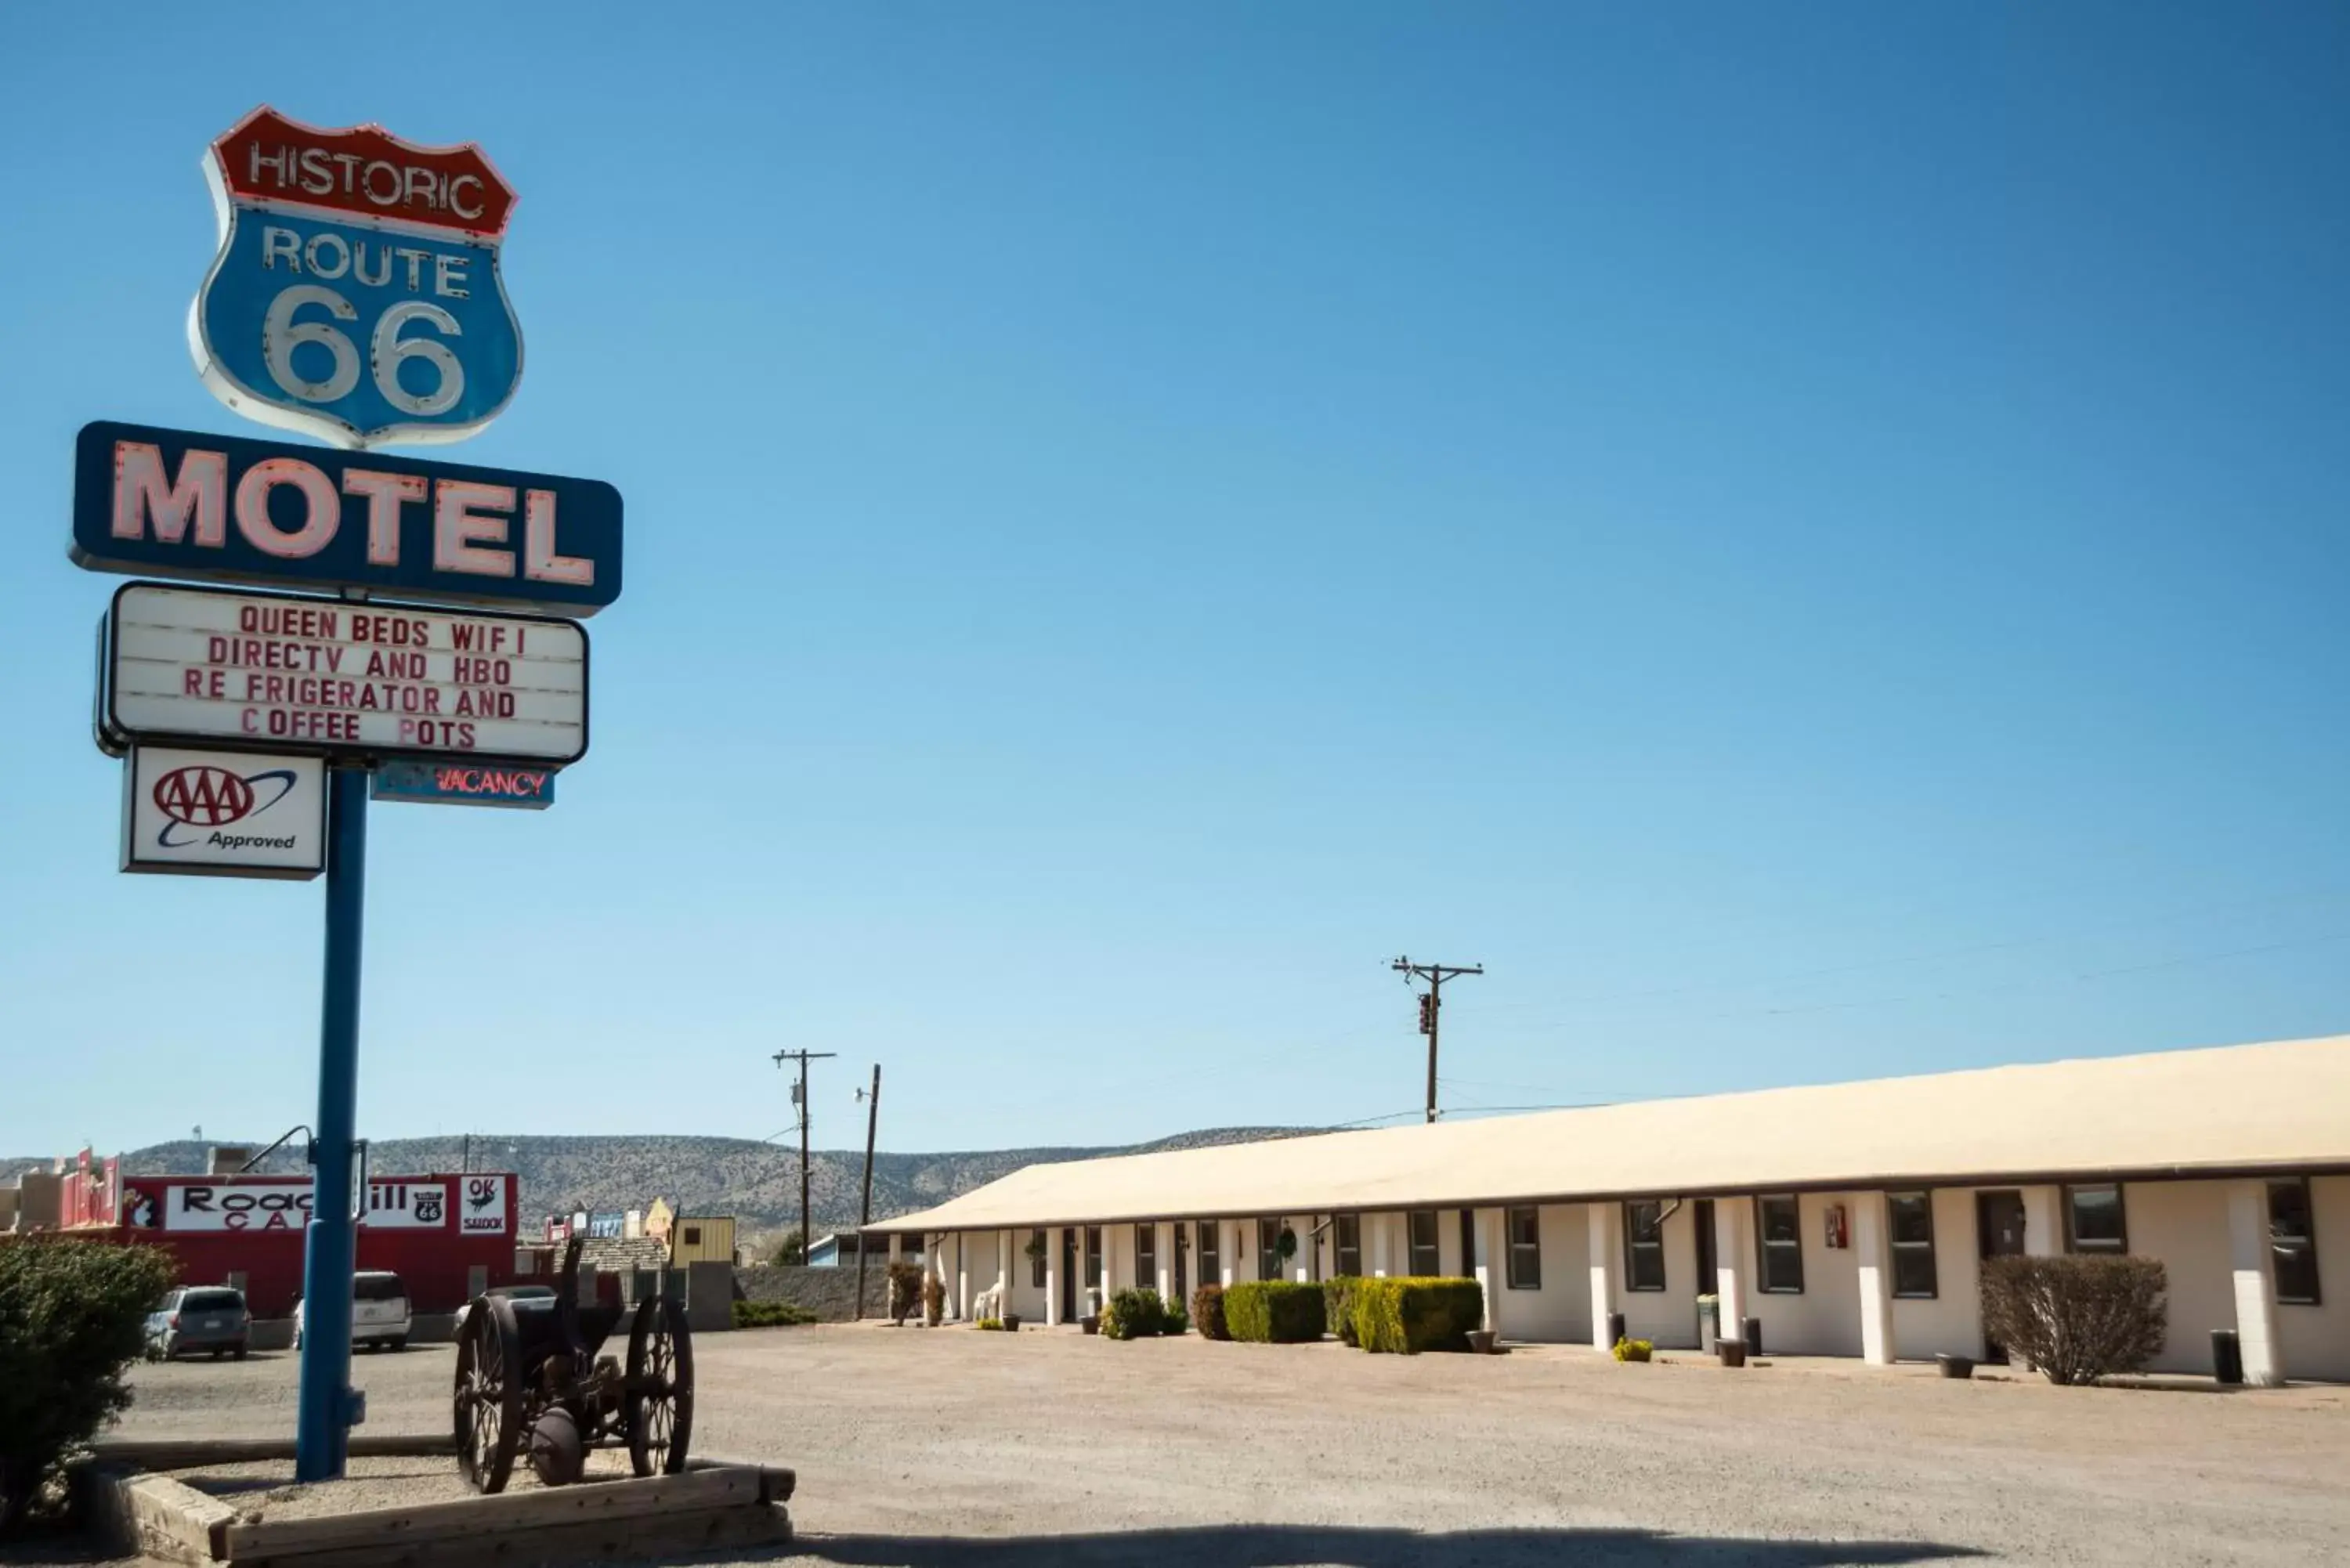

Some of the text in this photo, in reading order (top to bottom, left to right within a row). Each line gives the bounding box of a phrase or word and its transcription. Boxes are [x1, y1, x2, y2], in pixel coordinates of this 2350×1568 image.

[249, 140, 484, 220] HISTORIC
[261, 226, 471, 300] ROUTE
[262, 284, 465, 417] 66
[111, 439, 595, 587] MOTEL
[240, 605, 525, 655] QUEEN BEDS WIFI
[209, 636, 511, 686] DIRECTV AND HBO
[455, 688, 515, 718] AND
[242, 707, 476, 750] COFFEE POTS
[164, 767, 248, 826] AAA
[435, 768, 546, 797] VACANCY
[207, 831, 297, 850] Approved
[419, 1207, 438, 1219] 66
[469, 1179, 494, 1198] OK
